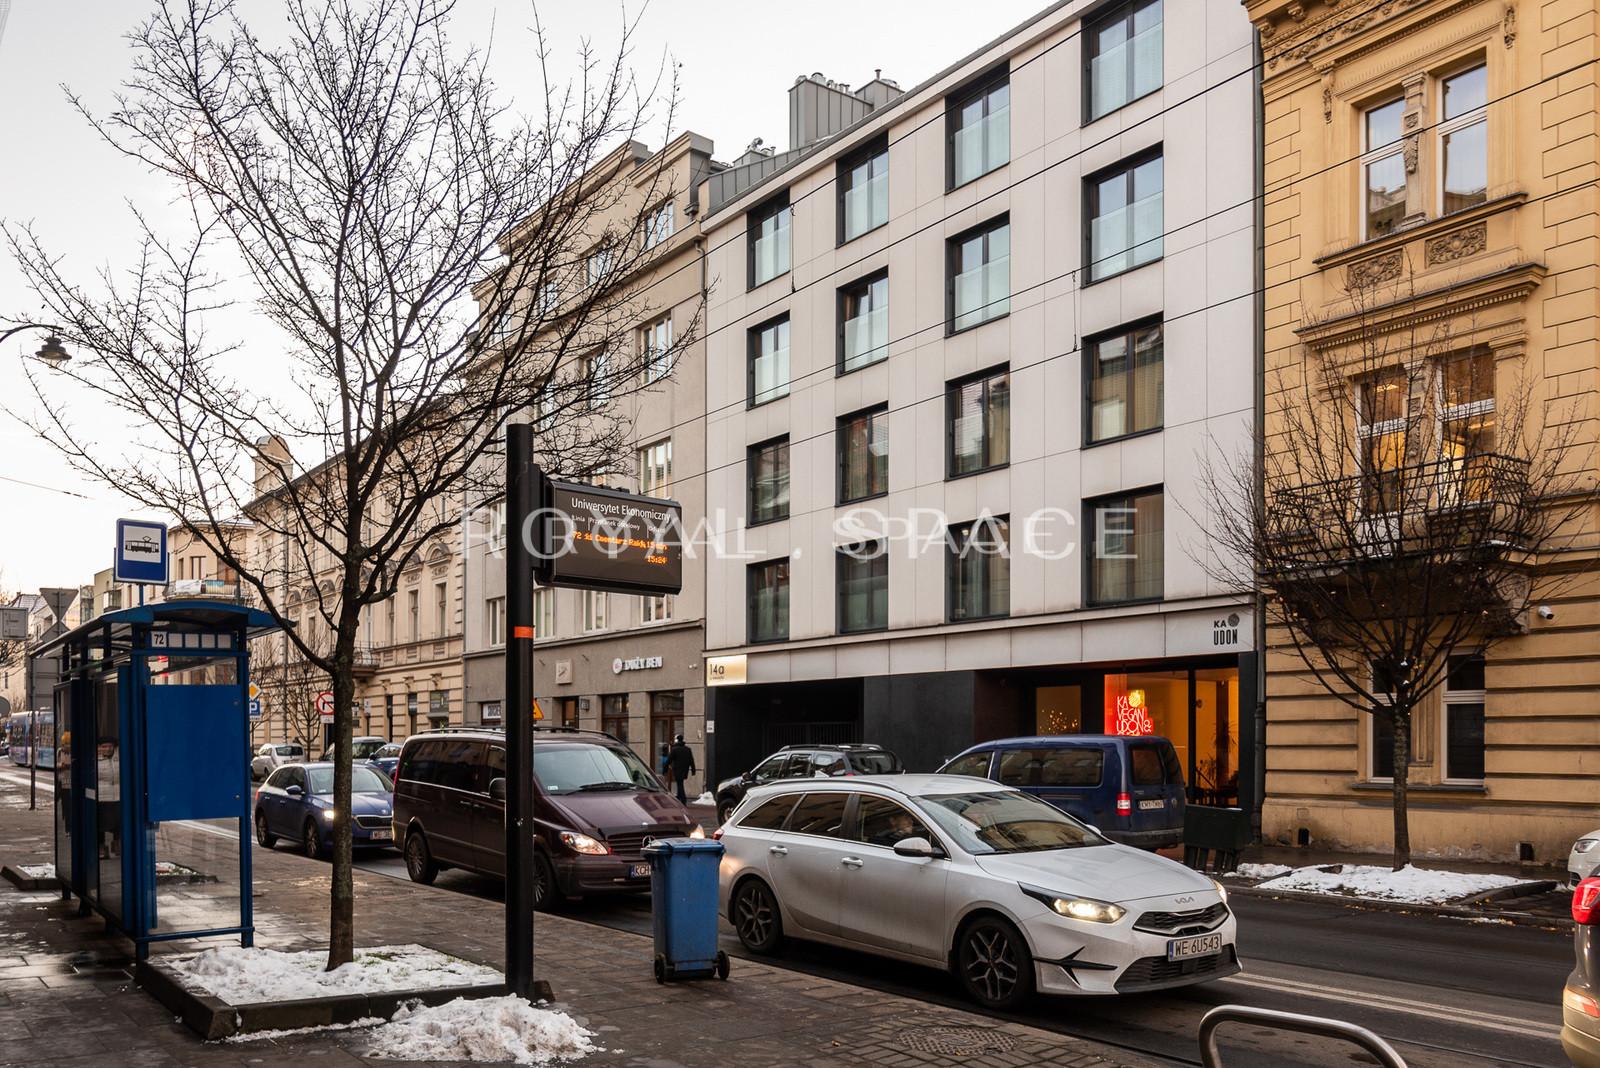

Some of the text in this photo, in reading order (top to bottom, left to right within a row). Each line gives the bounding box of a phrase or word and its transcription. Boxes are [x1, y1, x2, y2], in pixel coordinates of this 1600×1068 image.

[572, 498, 671, 523] Uniwersytet Ekonomiczny
[646, 555, 668, 564] 15:24
[154, 634, 164, 645] 72
[1213, 629, 1238, 645] UDON
[1117, 708, 1145, 721] VEGAN
[1116, 719, 1144, 733] UDON
[1175, 940, 1189, 956] WE
